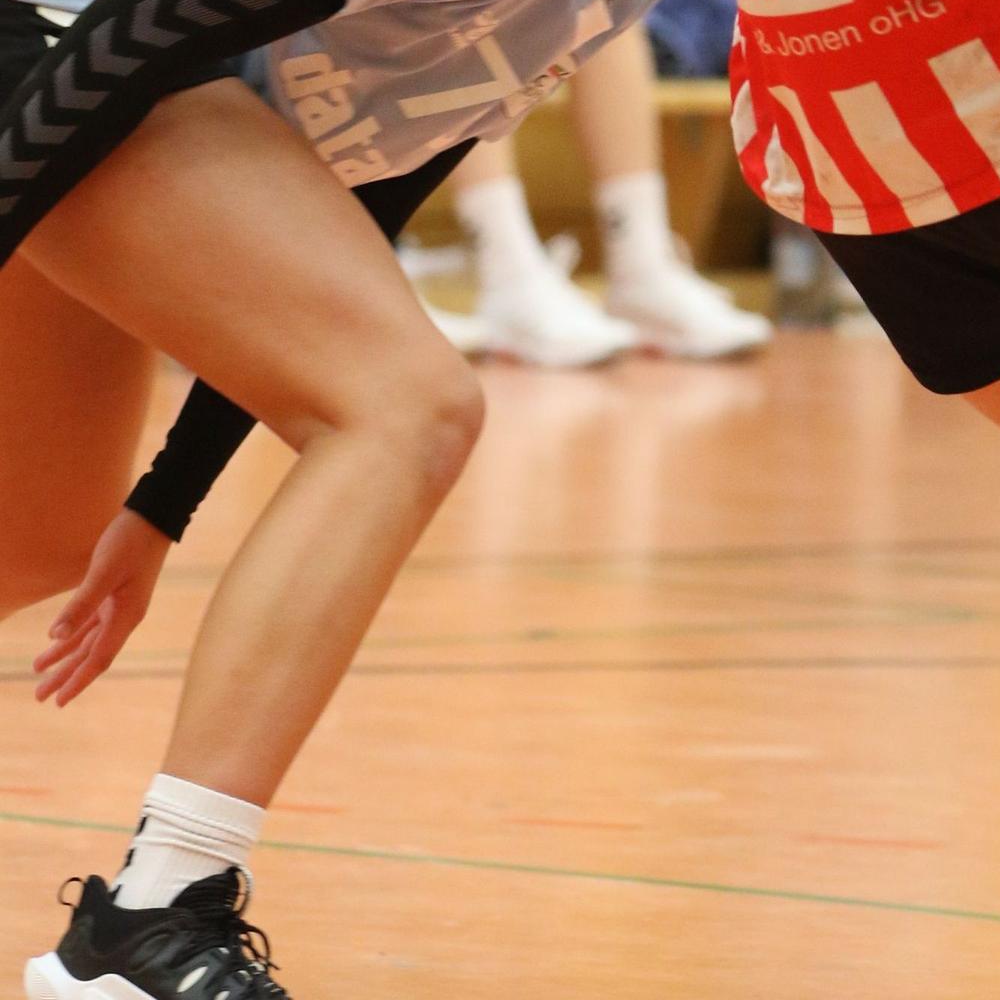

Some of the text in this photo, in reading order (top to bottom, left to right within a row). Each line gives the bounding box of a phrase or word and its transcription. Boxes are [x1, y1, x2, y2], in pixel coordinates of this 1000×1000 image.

[754, 29, 776, 55] &
[776, 23, 863, 57] Jonen
[280, 53, 388, 188] data
